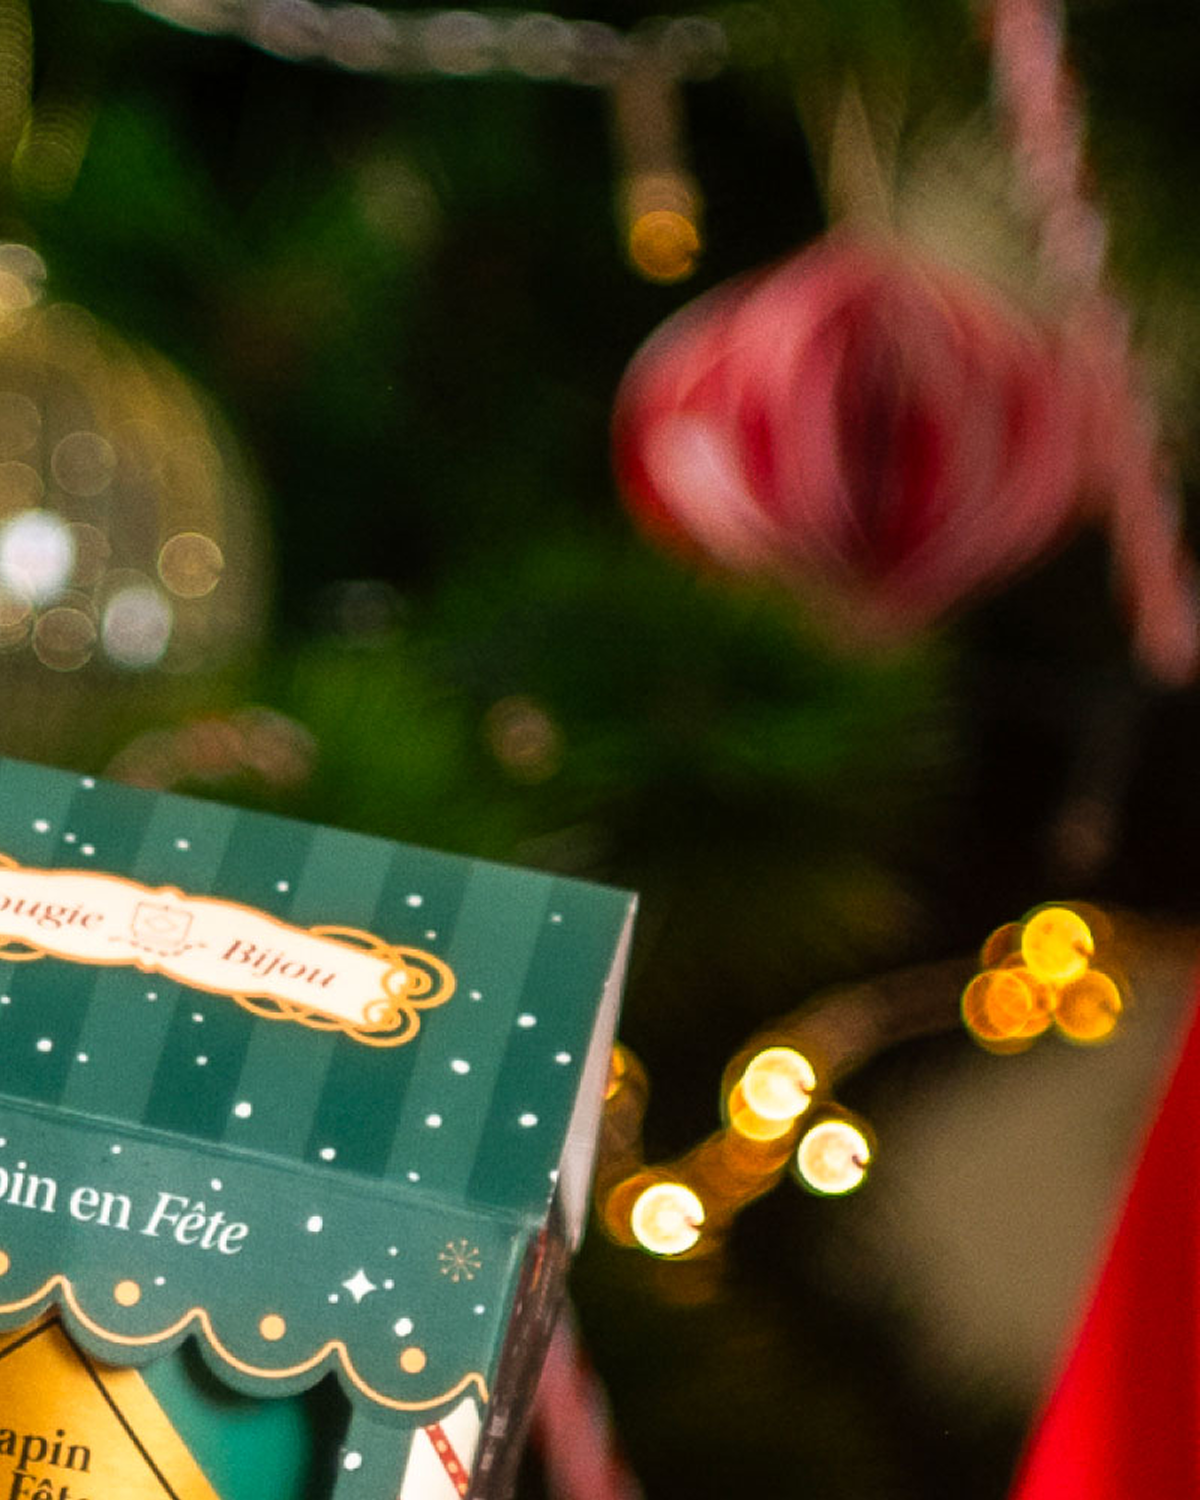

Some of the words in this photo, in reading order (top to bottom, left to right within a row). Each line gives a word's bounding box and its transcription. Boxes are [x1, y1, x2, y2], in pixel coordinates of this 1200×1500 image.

[221, 938, 337, 990] Bijou
[69, 1185, 132, 1231] en
[140, 1192, 249, 1255] Fête
